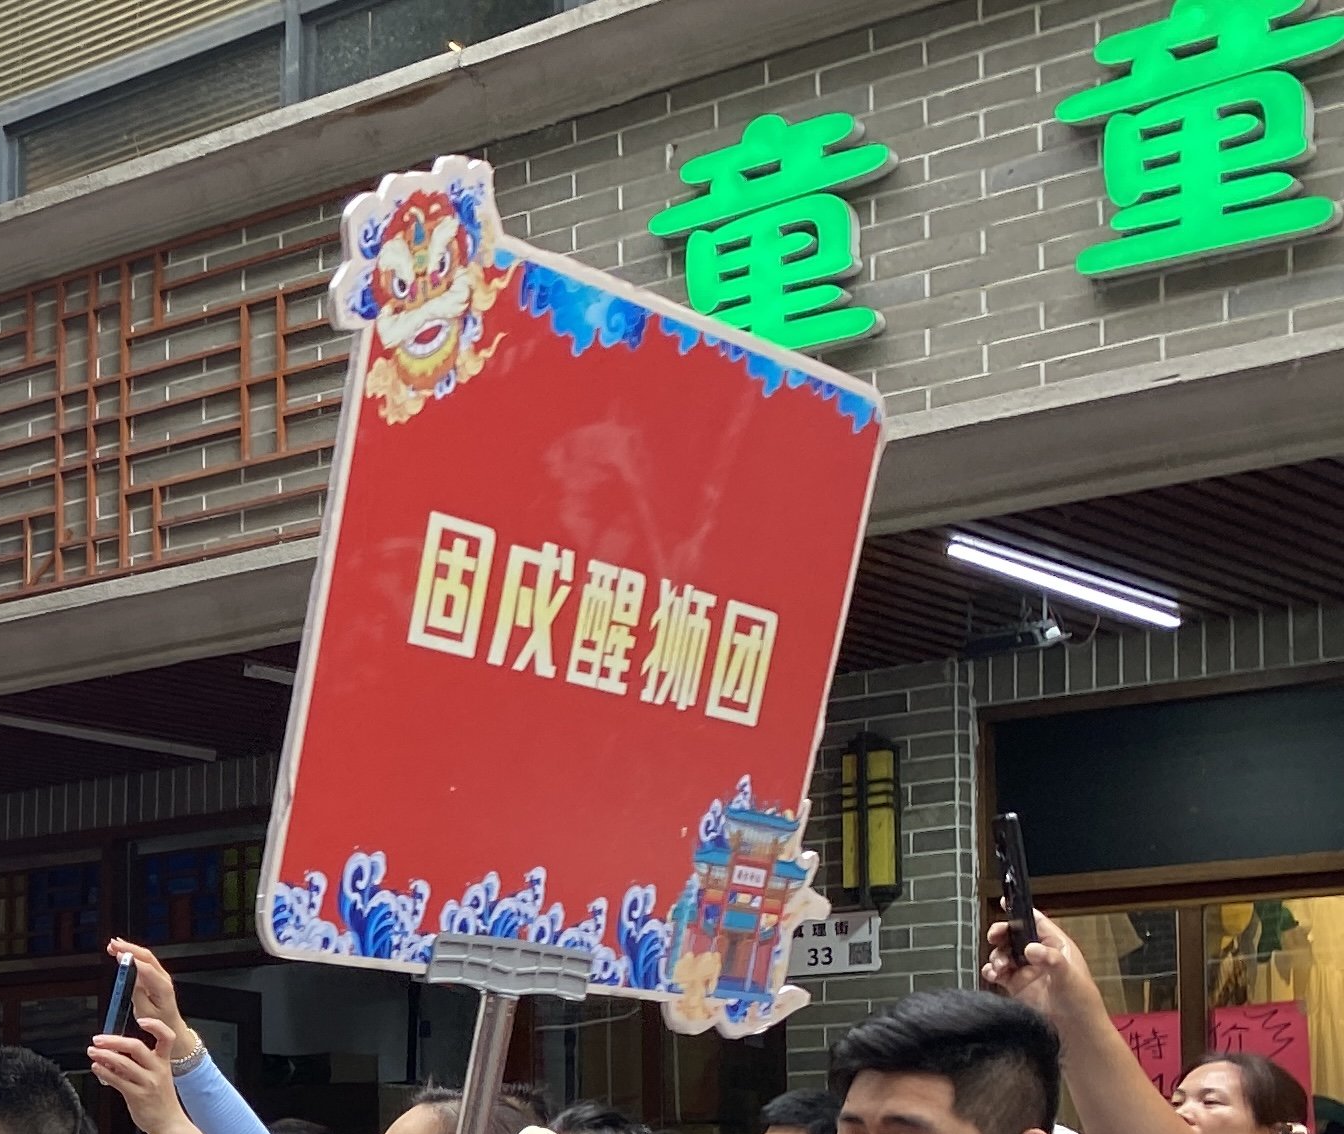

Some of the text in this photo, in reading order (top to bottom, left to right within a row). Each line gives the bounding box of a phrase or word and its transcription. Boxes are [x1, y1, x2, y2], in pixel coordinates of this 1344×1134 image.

[407, 511, 778, 727] 固戍醒狮团
[807, 947, 833, 966] 33
